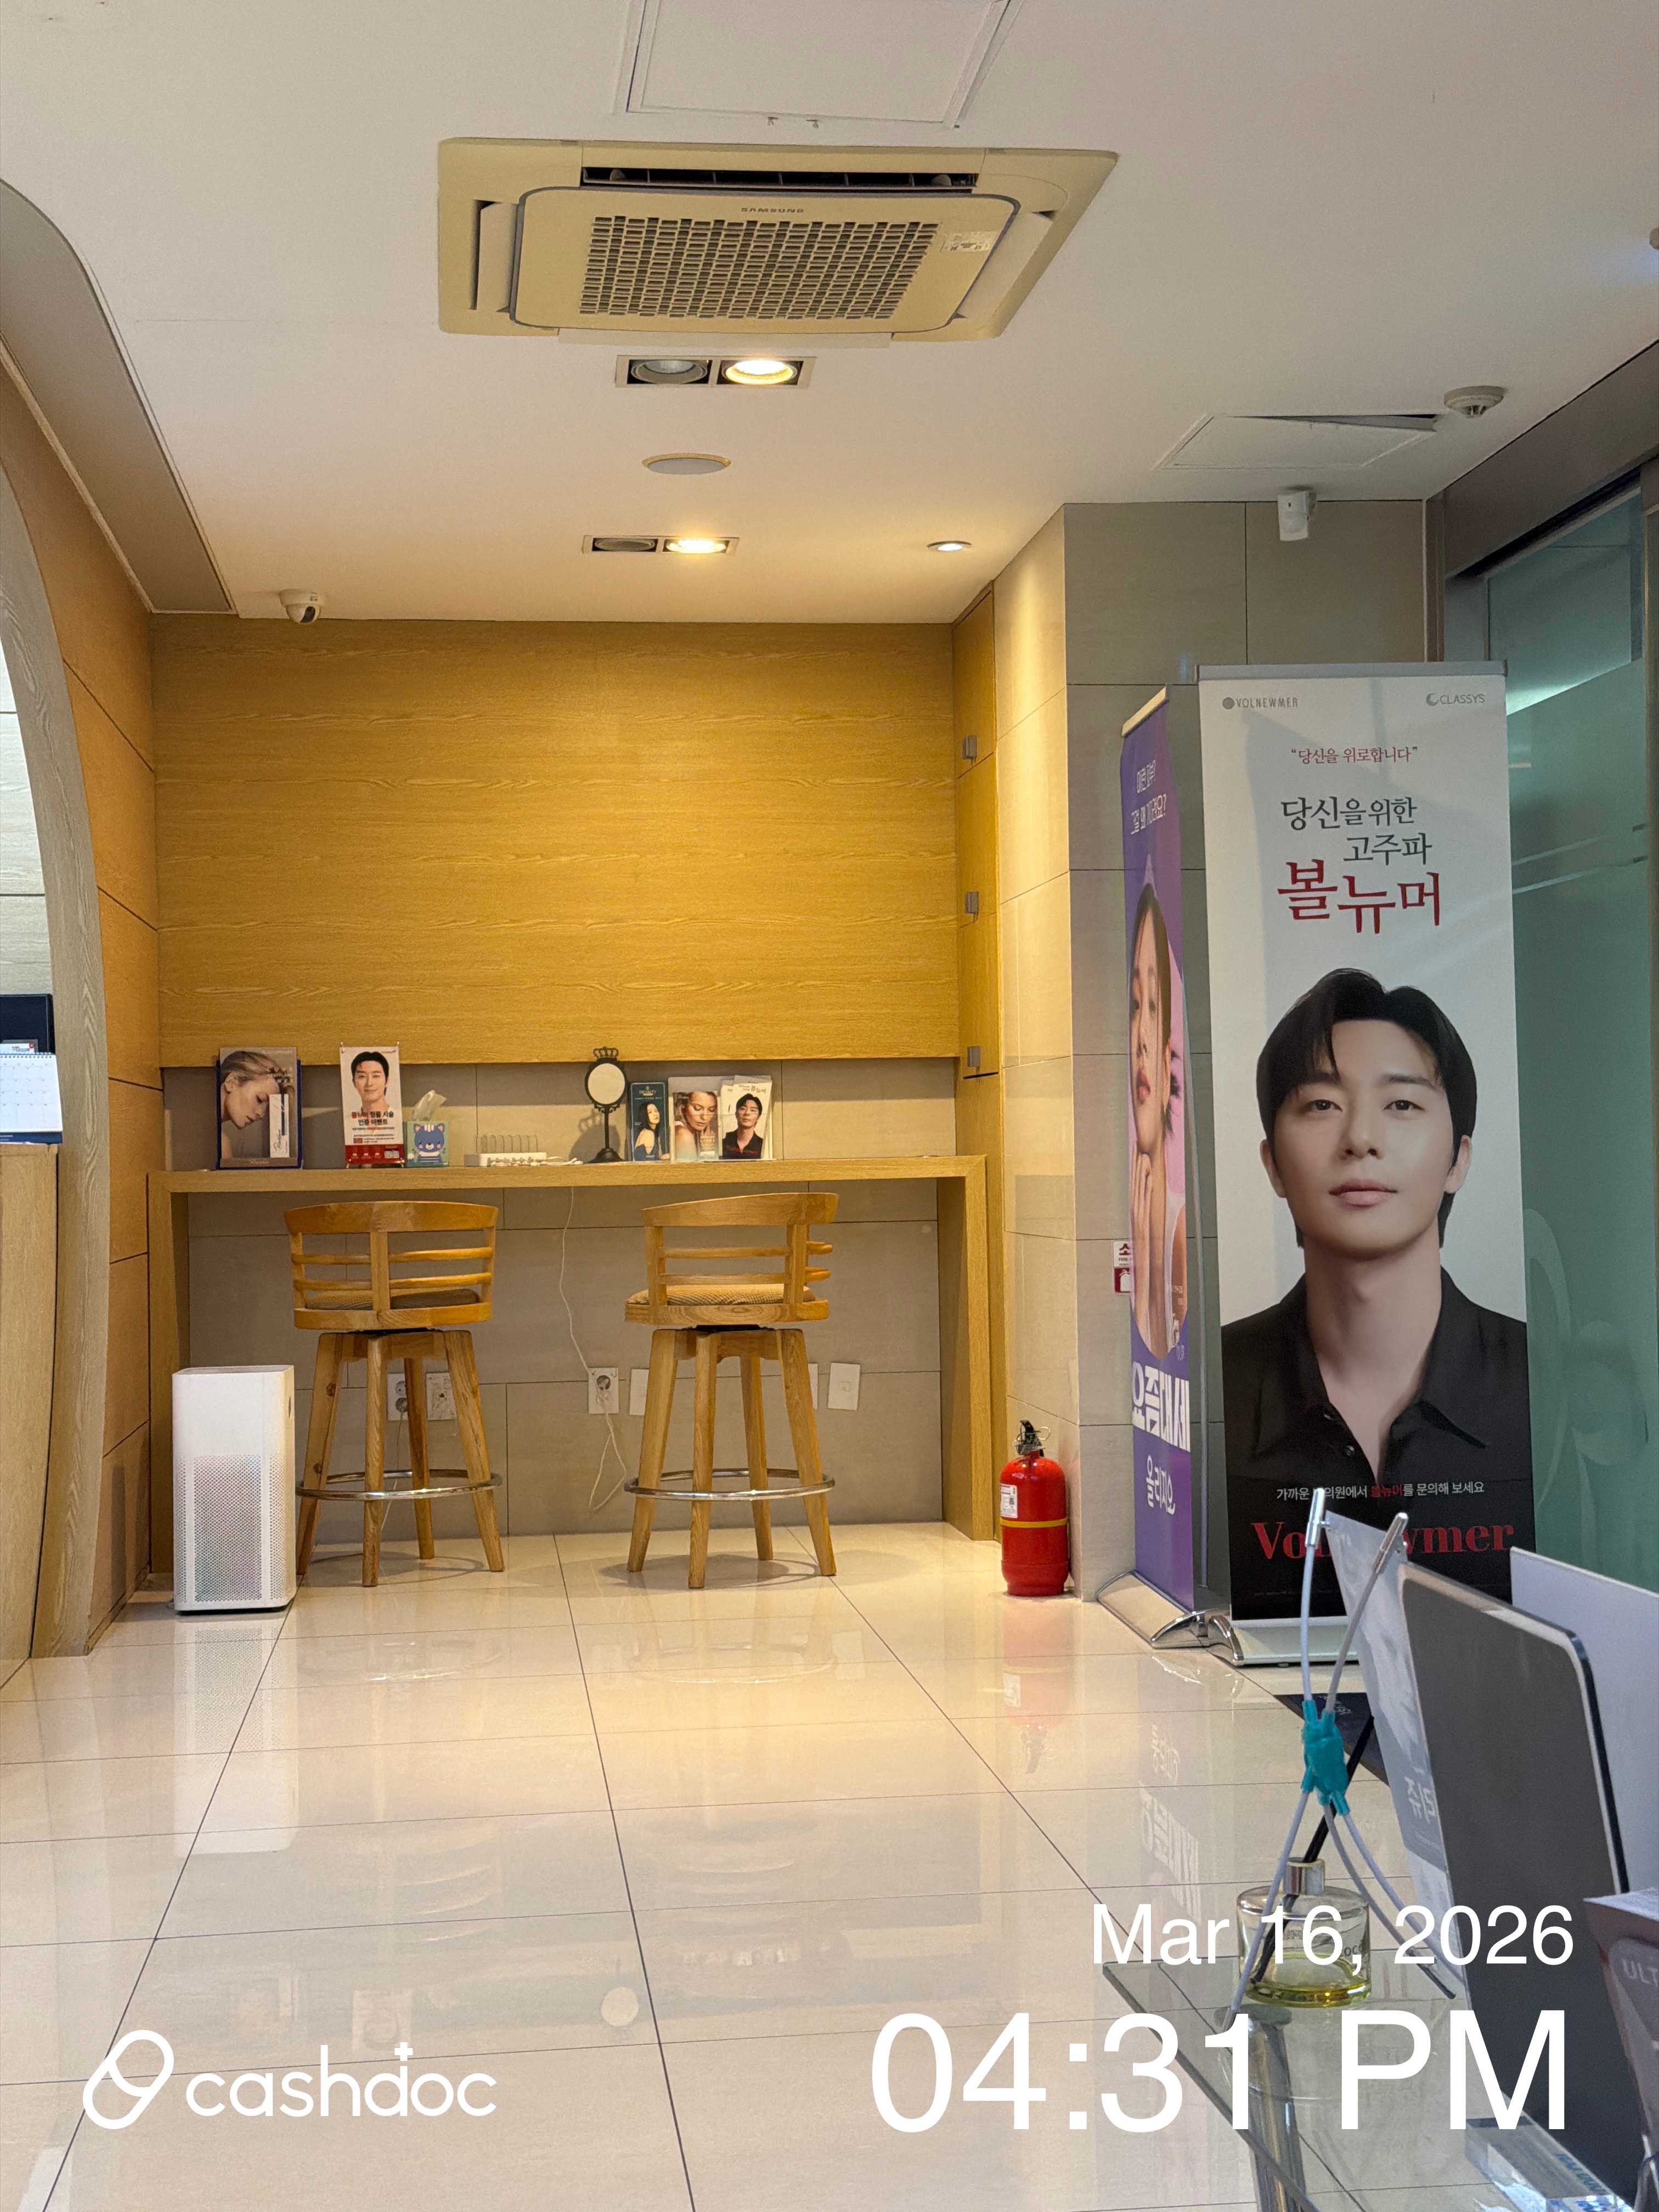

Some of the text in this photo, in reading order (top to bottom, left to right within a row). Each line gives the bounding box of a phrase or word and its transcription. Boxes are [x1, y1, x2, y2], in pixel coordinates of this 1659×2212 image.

[1236, 696, 1299, 708] VOLNEWMER
[1440, 695, 1486, 705] CLASSYS
[1342, 833, 1432, 866] 고주파
[1277, 859, 1441, 934] 볼뉴머
[1146, 1454, 1176, 1516] 올리지오
[1276, 1487, 1310, 1500] 가까운
[1416, 1482, 1449, 1496] 문의해
[1451, 1481, 1485, 1493] 보세요
